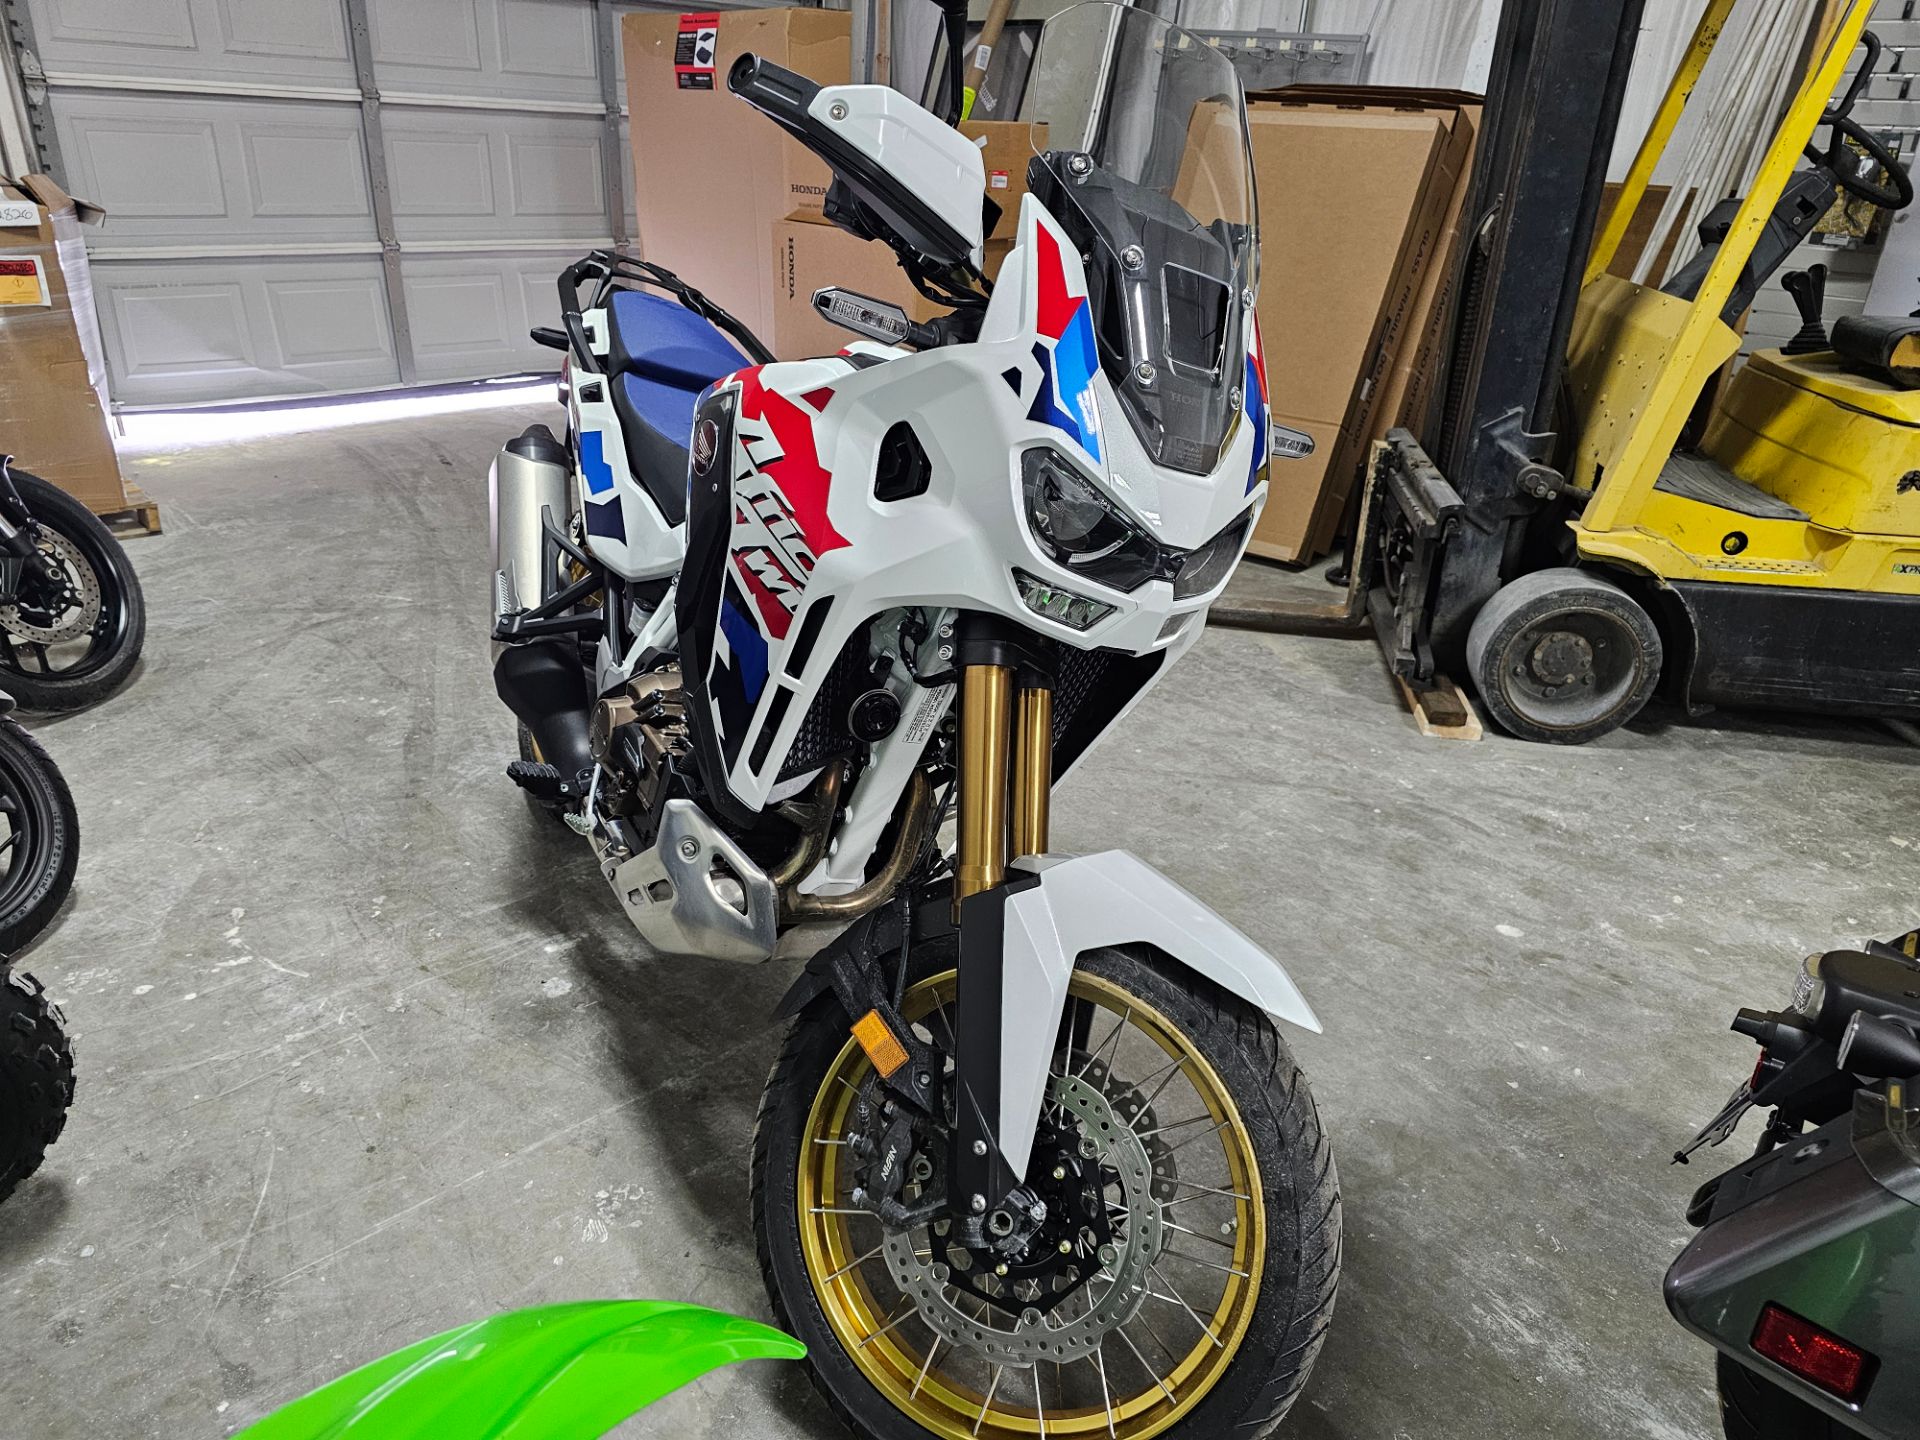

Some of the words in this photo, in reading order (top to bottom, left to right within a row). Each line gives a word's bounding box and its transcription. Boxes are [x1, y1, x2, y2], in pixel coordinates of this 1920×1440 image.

[790, 183, 827, 196] HONDA
[1411, 229, 1430, 275] GLASS
[1388, 285, 1412, 345] FRAGILE
[1376, 353, 1388, 375] DO
[1365, 375, 1380, 411] NOT
[881, 1144, 898, 1181] NISSIN
